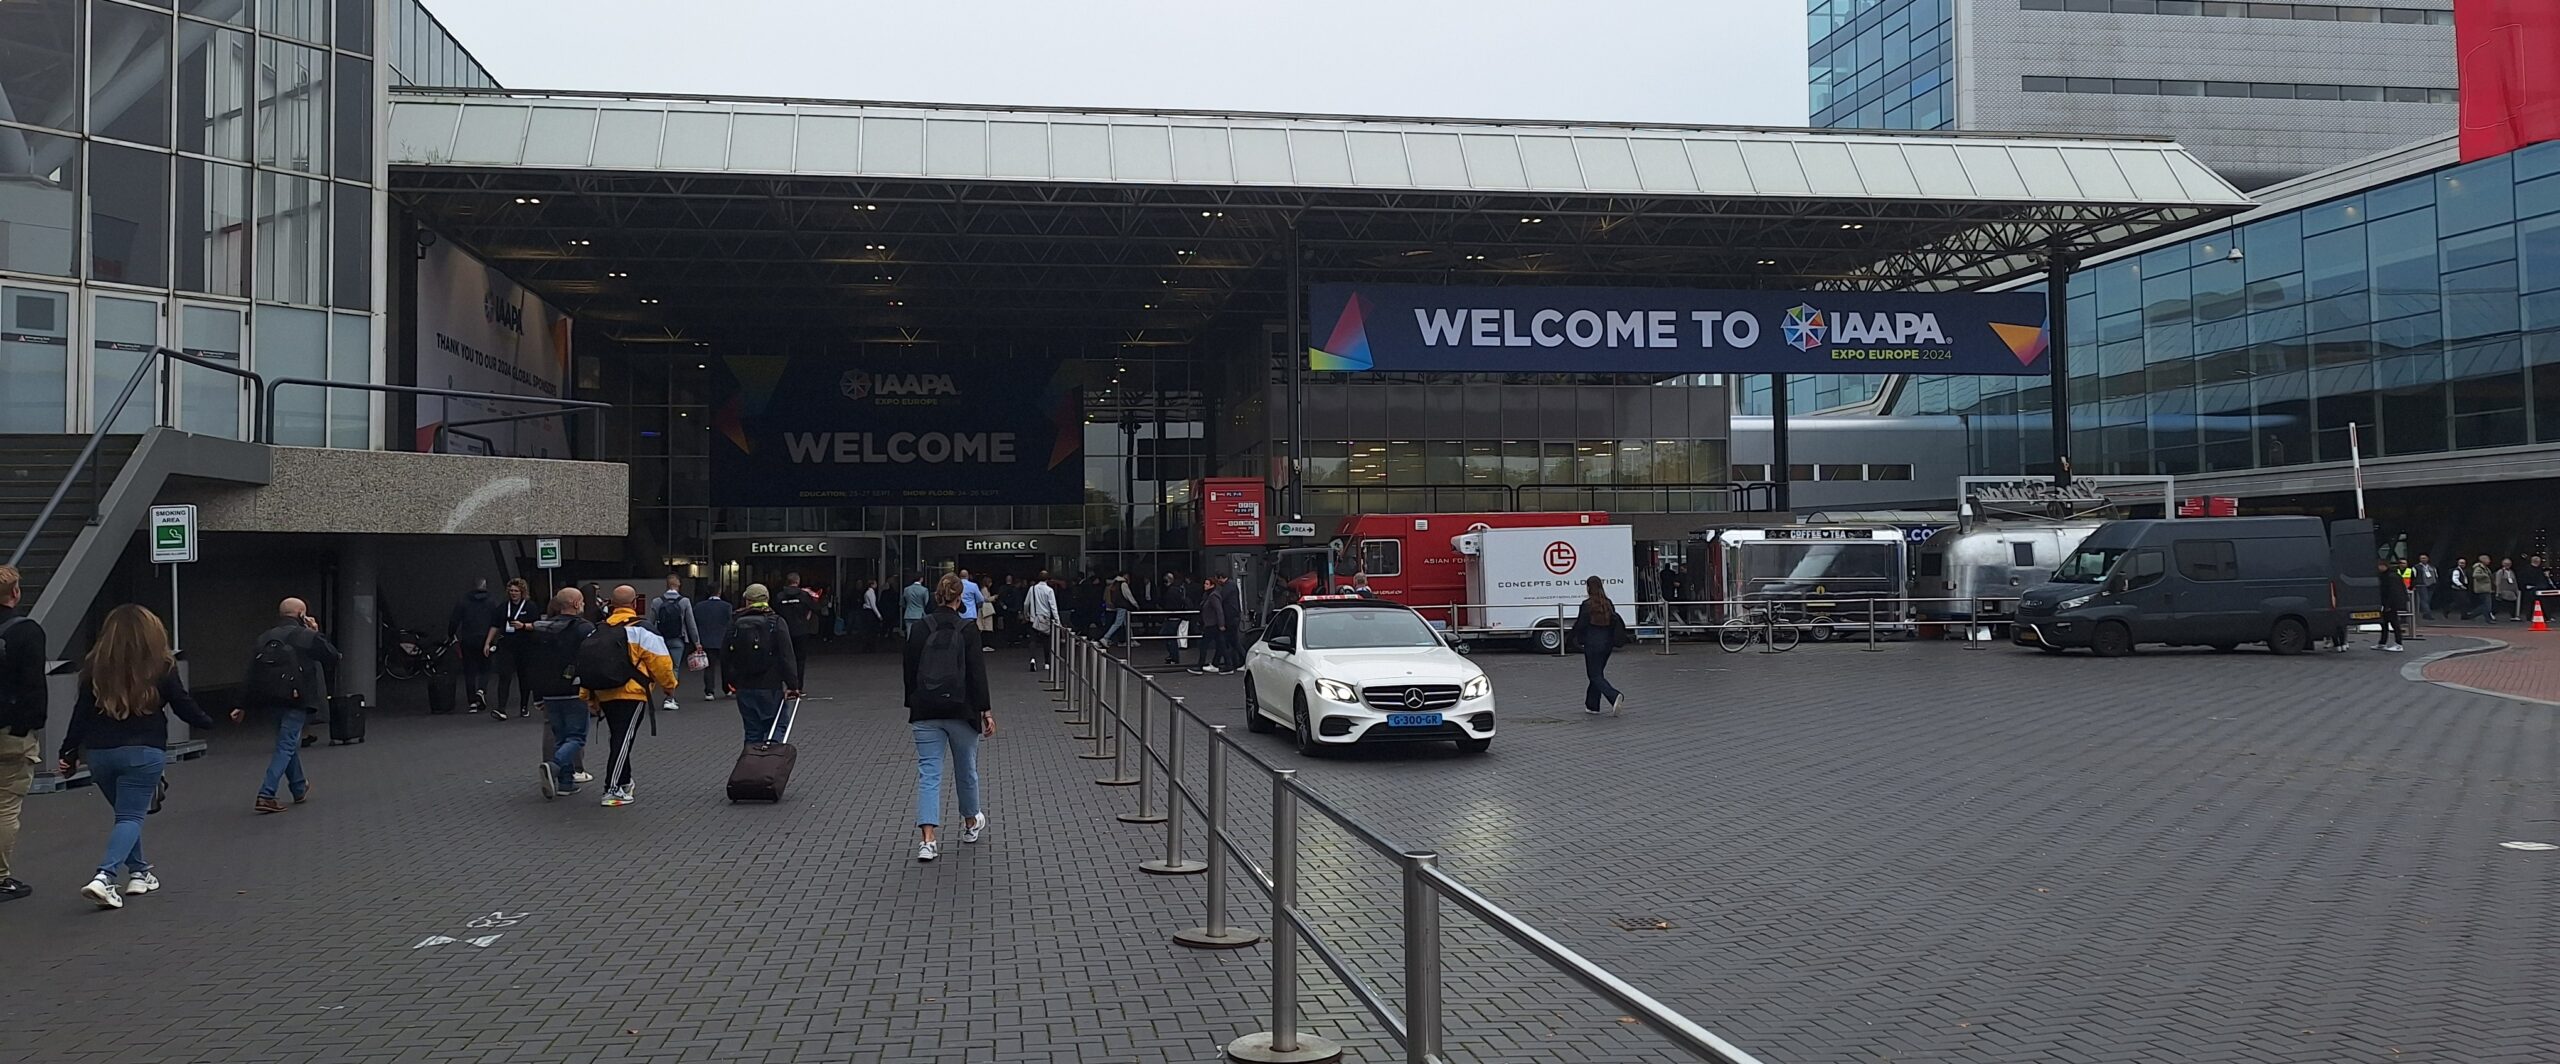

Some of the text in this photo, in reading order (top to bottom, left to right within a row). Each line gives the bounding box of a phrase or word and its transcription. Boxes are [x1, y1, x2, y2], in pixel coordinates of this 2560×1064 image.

[496, 296, 524, 336] IAAPA
[1414, 308, 1760, 348] WELCOME TO
[436, 332, 460, 357] THANK
[461, 343, 474, 362] YOU
[475, 350, 483, 367] TO
[484, 354, 497, 371] OUR
[497, 359, 511, 376] 2024
[512, 366, 532, 386] GLOBAL
[1831, 350, 1952, 360] EXPO EUROPE 2024
[783, 432, 1017, 464] WELCOME
[1790, 530, 1846, 539] COFFEE TEA
[751, 542, 828, 553] Entrance C
[966, 539, 1038, 550] Entrance C
[1497, 580, 1552, 588] CONCEPTS
[1574, 578, 1624, 586] LOTION
[1393, 715, 1438, 725] G-300-GR
